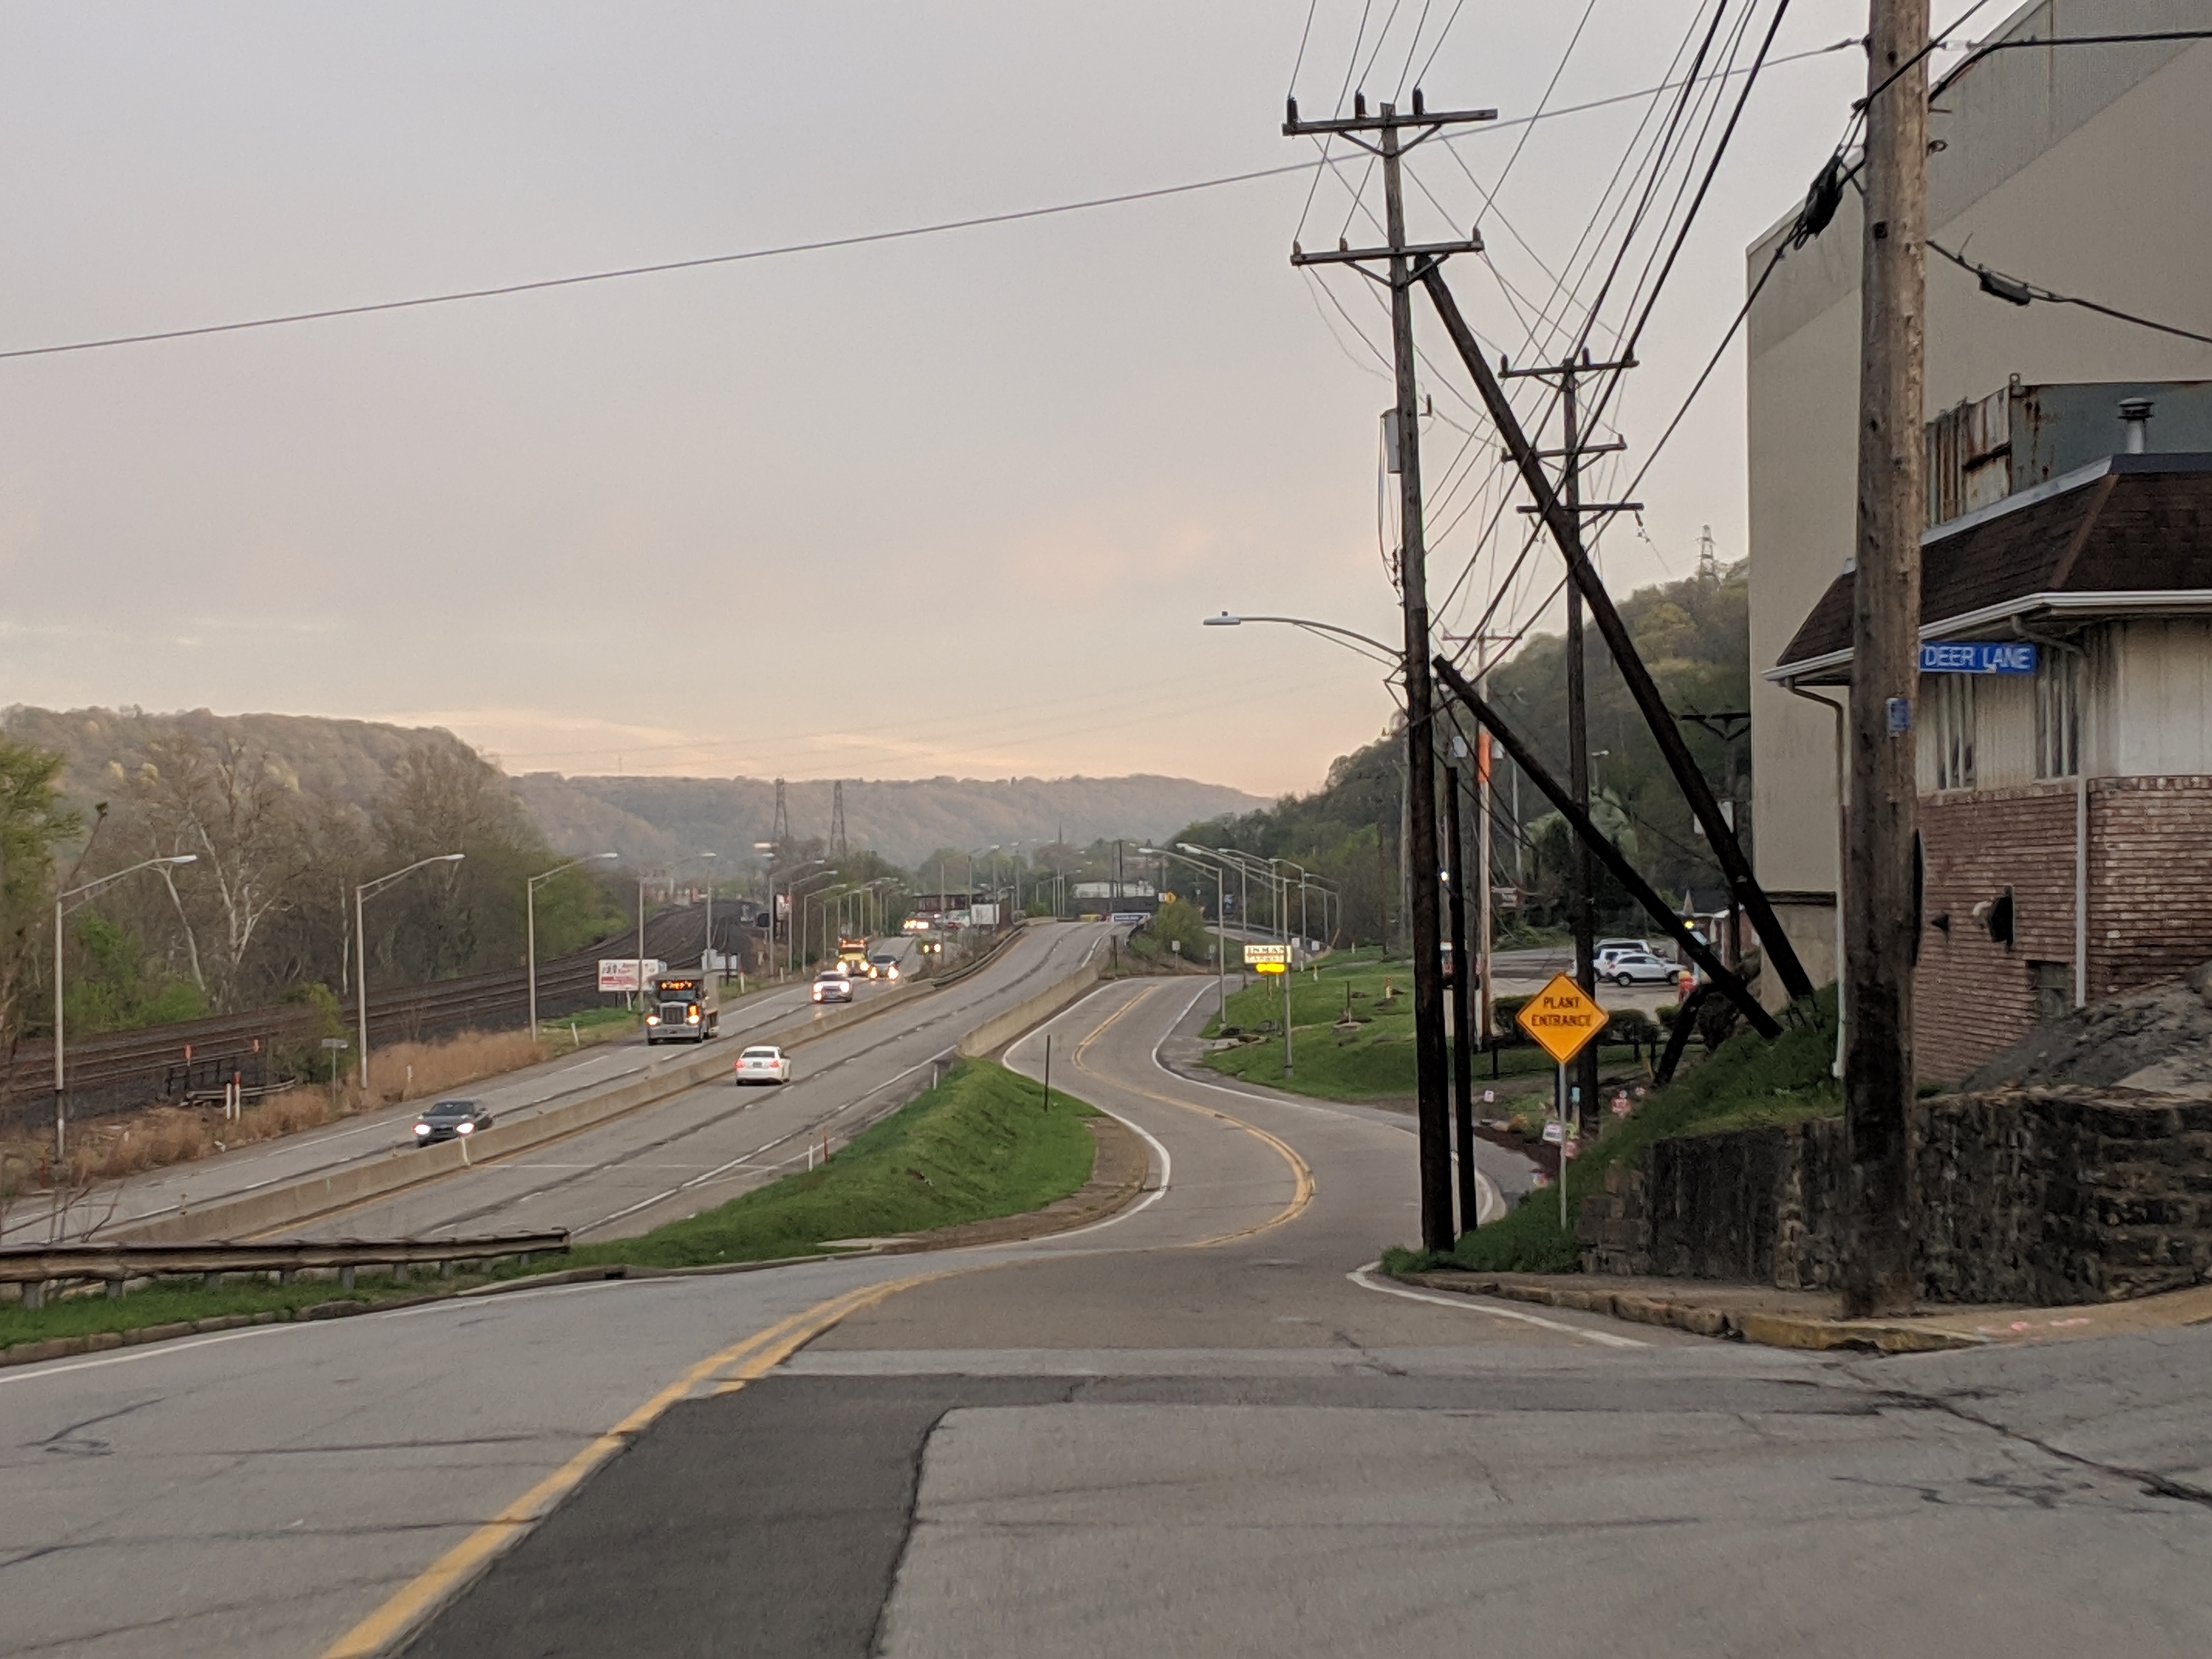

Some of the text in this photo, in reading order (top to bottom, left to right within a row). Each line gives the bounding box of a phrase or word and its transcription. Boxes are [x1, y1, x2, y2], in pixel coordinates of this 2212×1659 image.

[1925, 646, 2030, 669] DEER LANE
[1543, 996, 1580, 1009] PLANT
[1531, 1014, 1591, 1026] ENTRANCE
